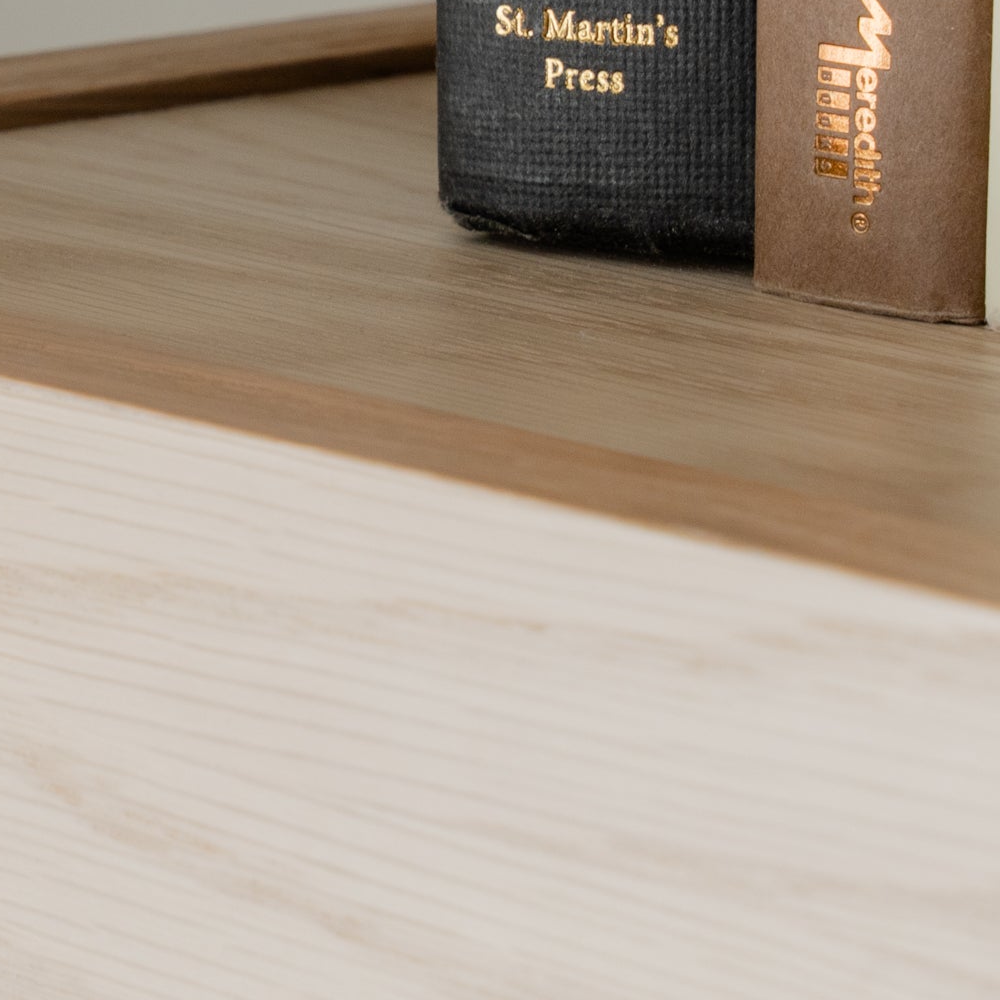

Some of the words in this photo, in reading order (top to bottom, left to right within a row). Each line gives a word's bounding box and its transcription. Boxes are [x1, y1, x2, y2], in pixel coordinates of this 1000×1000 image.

[494, 4, 534, 38] St.
[543, 7, 680, 48] Martin's
[544, 56, 626, 94] Press
